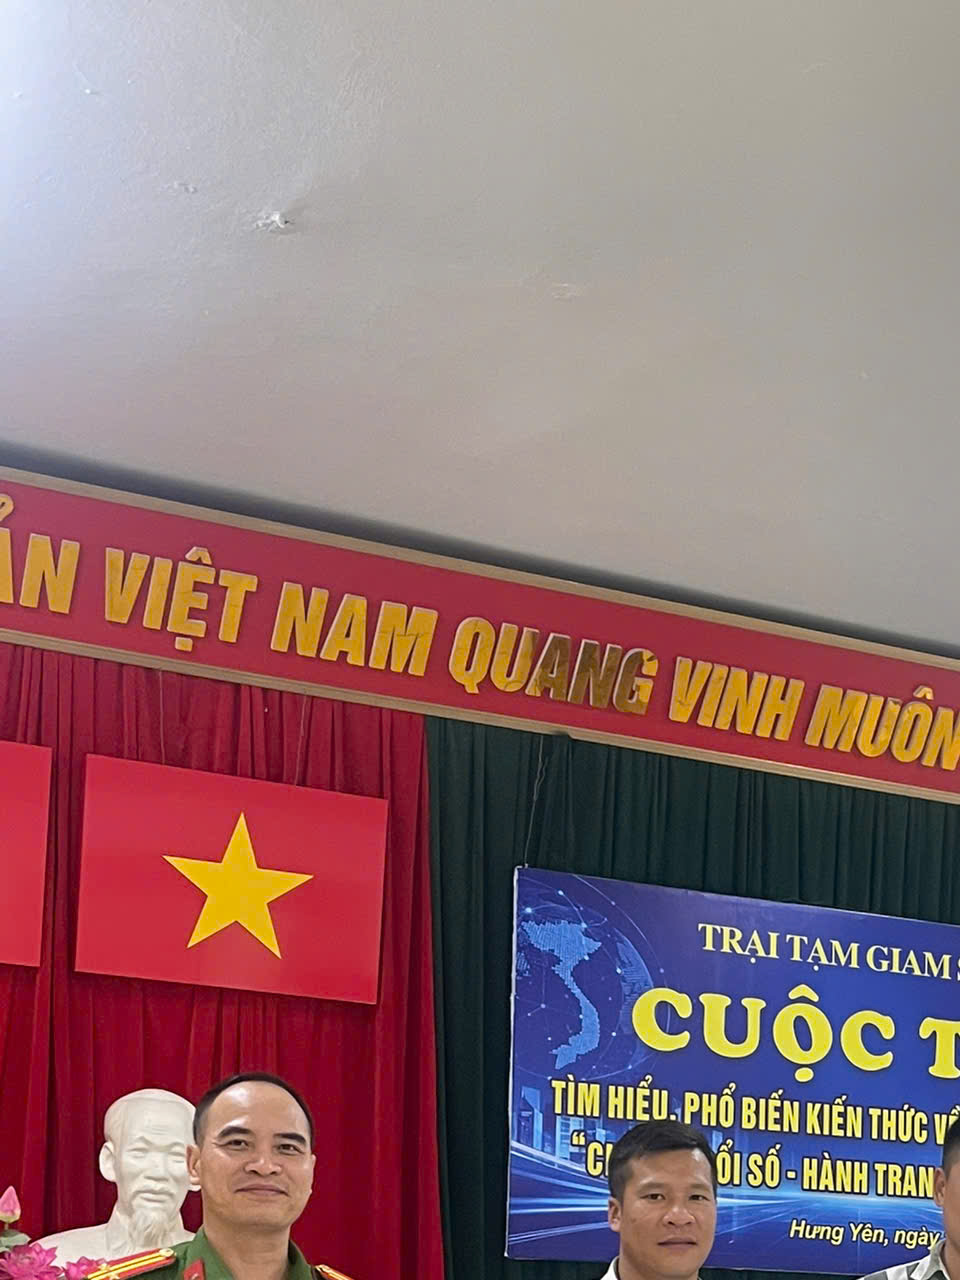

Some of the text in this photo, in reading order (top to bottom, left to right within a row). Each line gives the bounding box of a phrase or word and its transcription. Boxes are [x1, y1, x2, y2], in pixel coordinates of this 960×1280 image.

[103, 546, 258, 652] VIỆT
[271, 580, 438, 677] NAM
[448, 615, 659, 715] QUANG
[668, 655, 804, 742] VINH
[698, 922, 779, 964] TRẠI
[786, 934, 860, 972] TẠM
[866, 944, 952, 980] GIAM
[631, 983, 896, 1083] CUỘC
[551, 1074, 600, 1117] TÌM
[684, 1082, 737, 1128] PHỔ
[741, 1088, 800, 1133] BIẾN
[806, 1095, 863, 1138] KIẾN
[868, 1103, 928, 1144] THỨC
[747, 1143, 782, 1188] SỐ
[803, 1152, 868, 1194] HÀNH
[873, 1163, 935, 1198] TRAN
[789, 1219, 844, 1246] Hưng
[849, 1222, 889, 1247] Yên,
[894, 1226, 942, 1251] ngày
